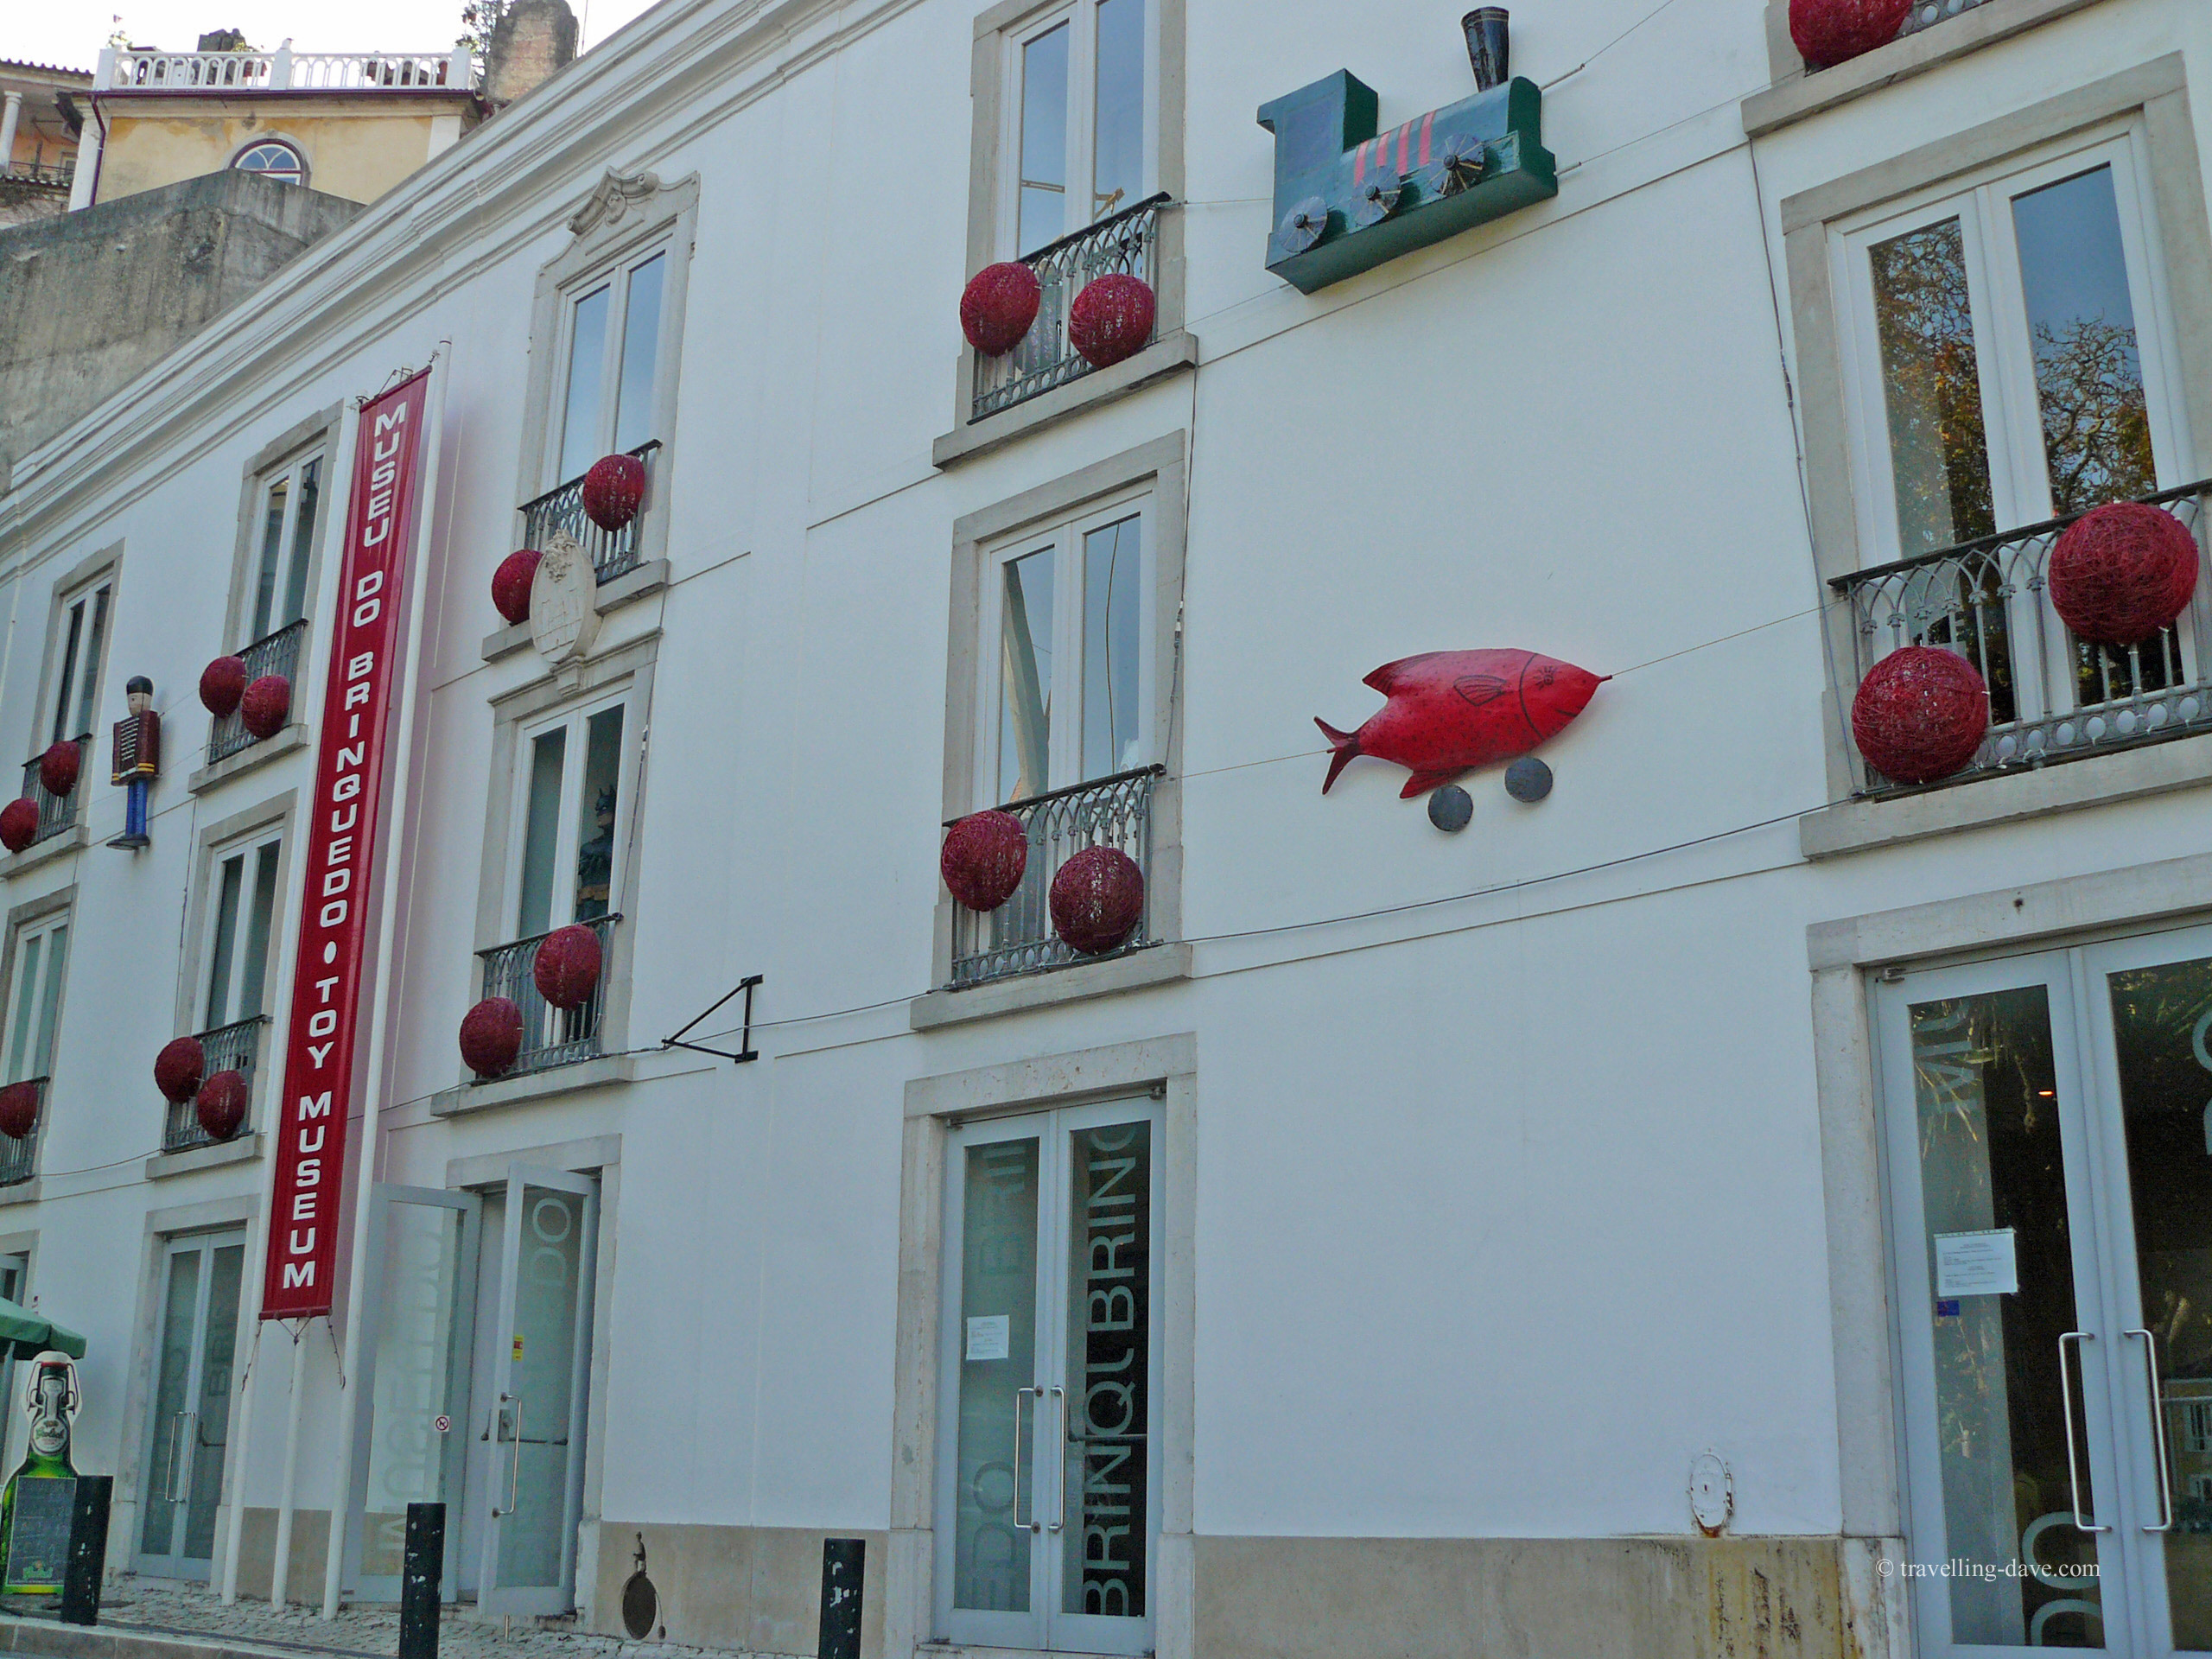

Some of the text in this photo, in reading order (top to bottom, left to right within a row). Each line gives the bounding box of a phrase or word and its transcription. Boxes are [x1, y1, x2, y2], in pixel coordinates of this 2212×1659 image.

[283, 401, 407, 1289] MUSEU DO BRINQUEDO TOY MUSEUM
